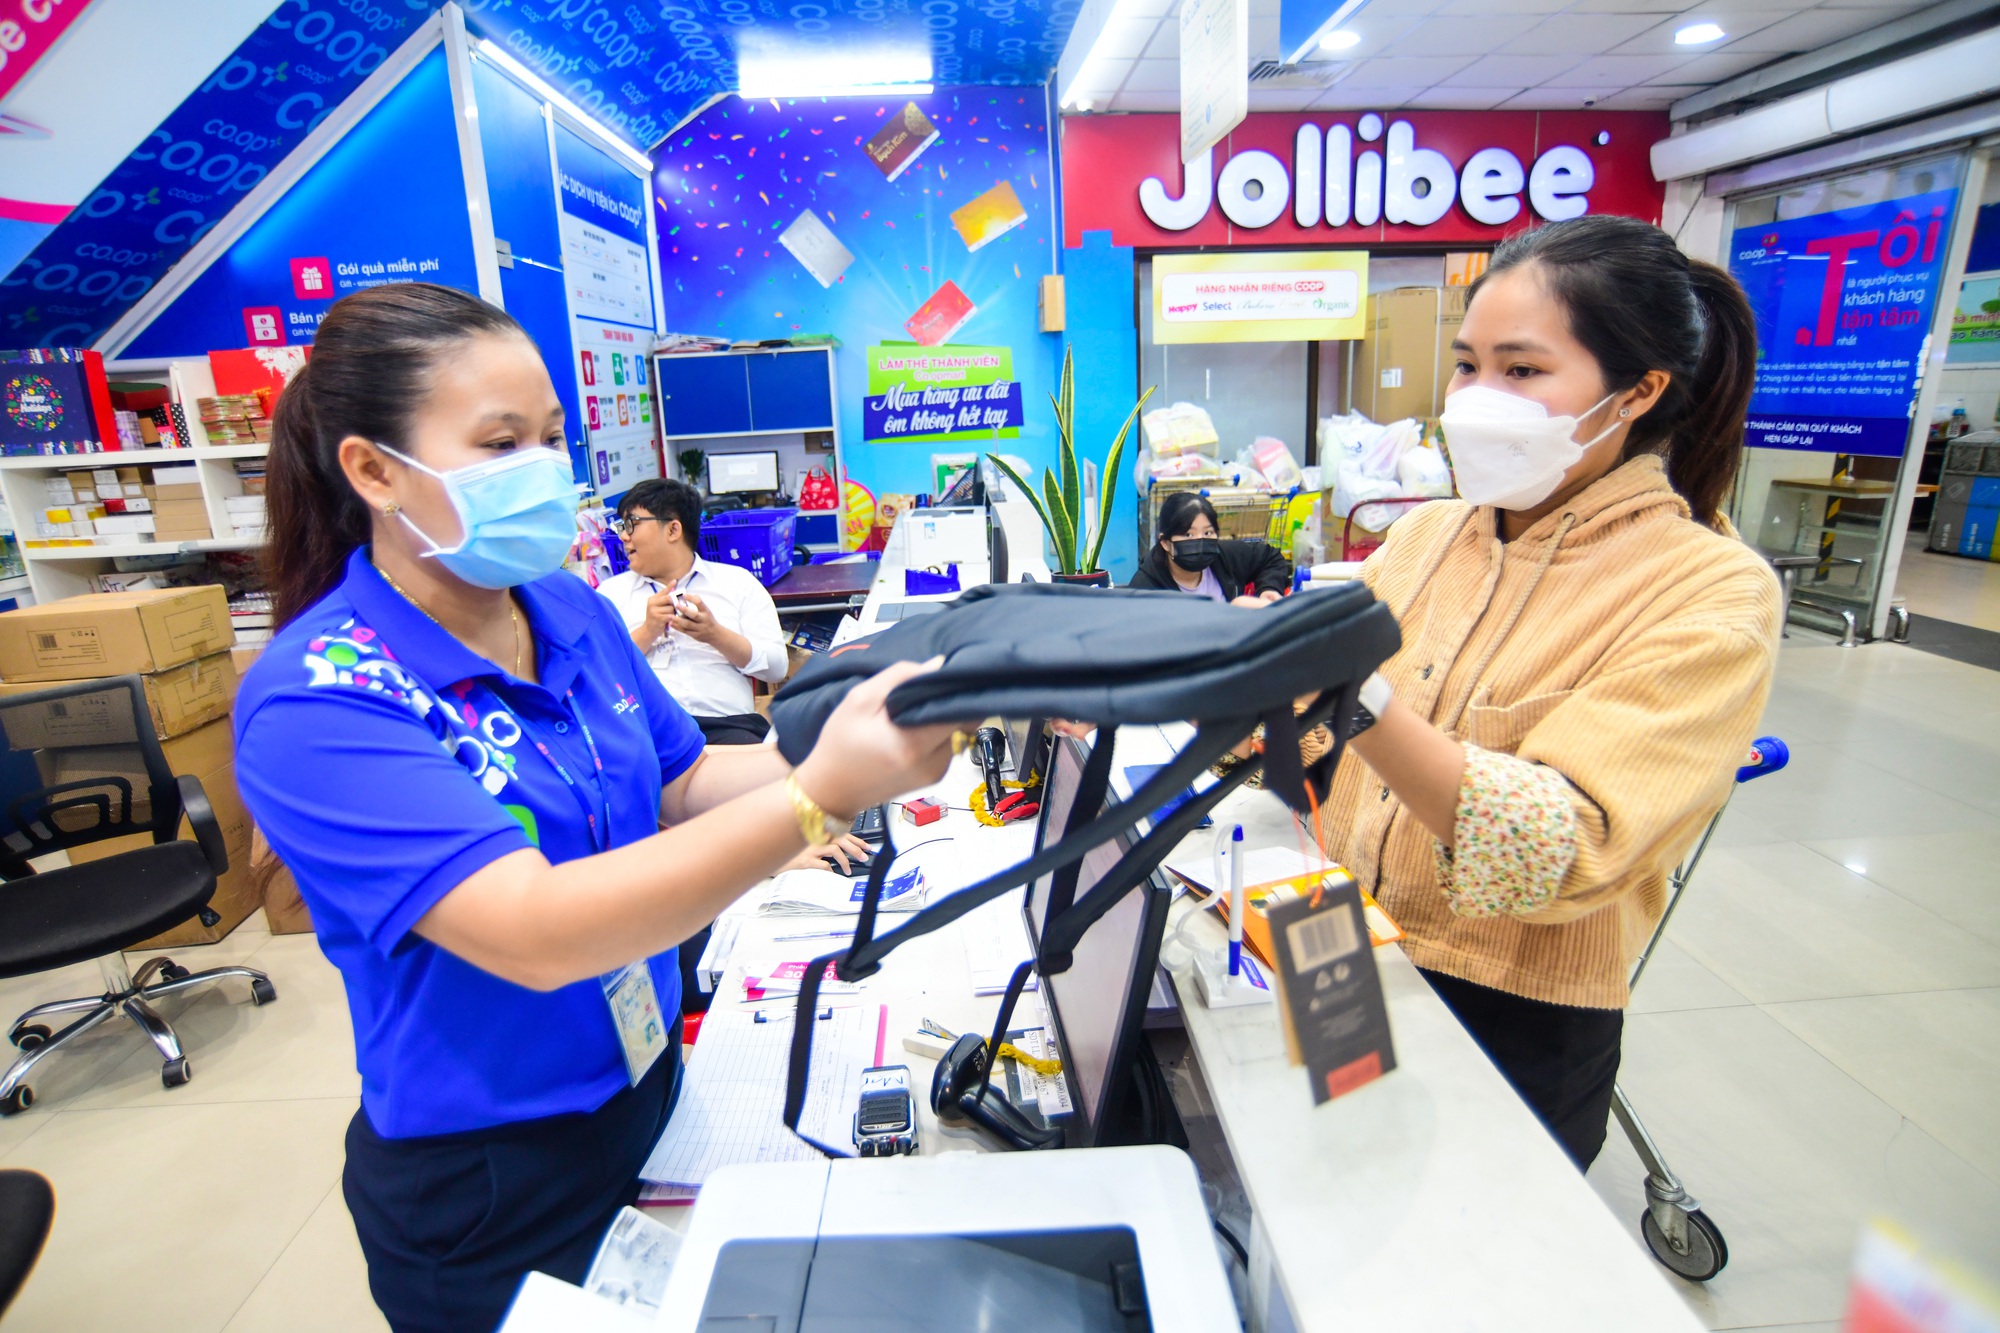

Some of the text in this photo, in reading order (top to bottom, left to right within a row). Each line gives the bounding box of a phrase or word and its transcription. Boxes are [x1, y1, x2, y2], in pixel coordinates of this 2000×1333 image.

[203, 119, 268, 153] co.op
[1139, 113, 1595, 231] Jollibee
[75, 242, 148, 268] co.op
[337, 257, 439, 277] Gói quà miễn phí
[1196, 284, 1226, 294] HÀNG
[1262, 282, 1292, 293] RIÊNG
[1295, 281, 1324, 292] COOP
[1844, 288, 1926, 306] khách hàng
[1168, 303, 1198, 314] Happy
[1203, 301, 1231, 311] Select
[1313, 298, 1351, 312] Organic
[289, 312, 314, 325] Bán
[1842, 306, 1920, 334] tận tâm
[879, 355, 903, 371] LÀM
[932, 355, 970, 369] THÀNH
[973, 355, 999, 367] VIÊN
[871, 382, 920, 412] Mua
[922, 384, 960, 409] hàng
[984, 378, 1011, 400] đãi
[884, 404, 1009, 435] ôm không hết tay
